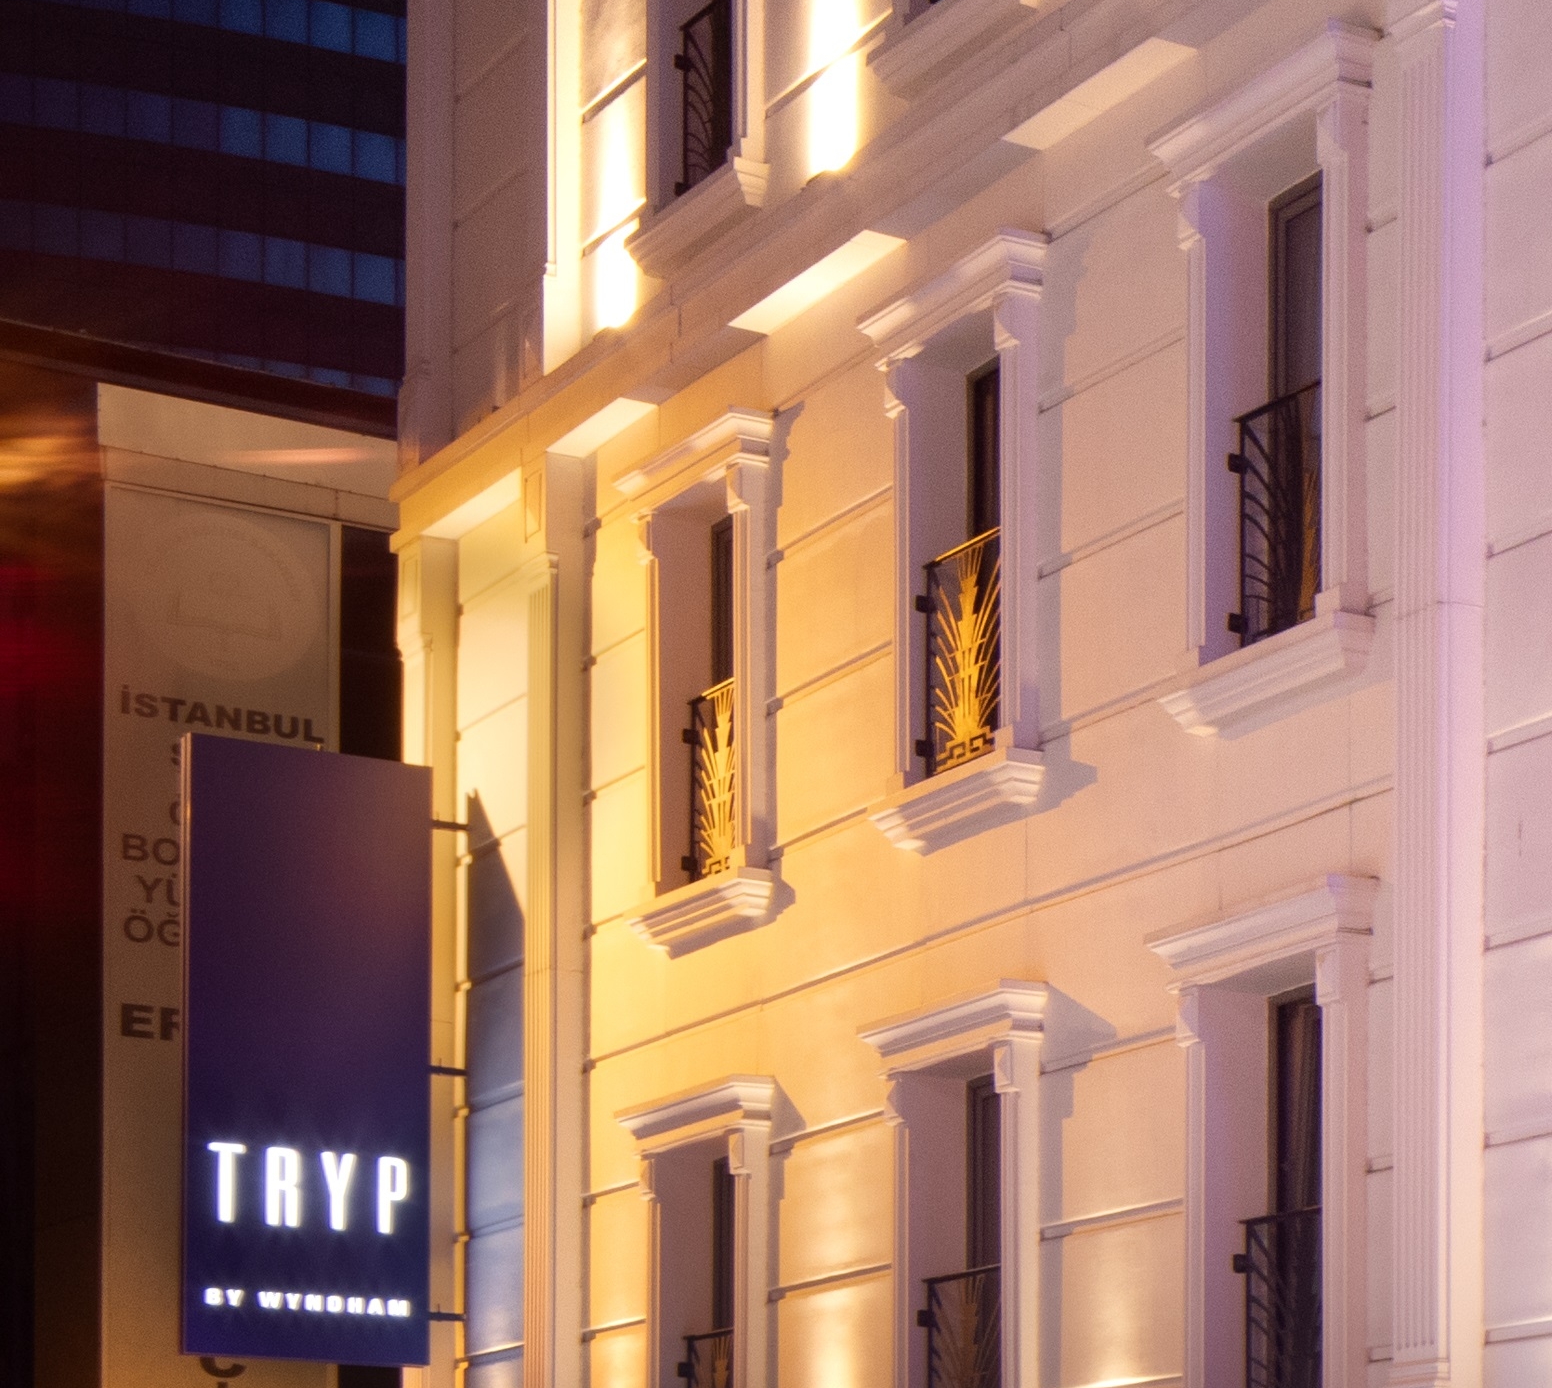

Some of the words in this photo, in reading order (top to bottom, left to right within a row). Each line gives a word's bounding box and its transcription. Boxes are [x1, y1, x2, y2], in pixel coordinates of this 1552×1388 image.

[120, 684, 325, 743] İSTANBUL
[206, 1141, 410, 1235] TRYP
[203, 1287, 245, 1308] BY
[257, 1290, 411, 1318] WYNDHAM
